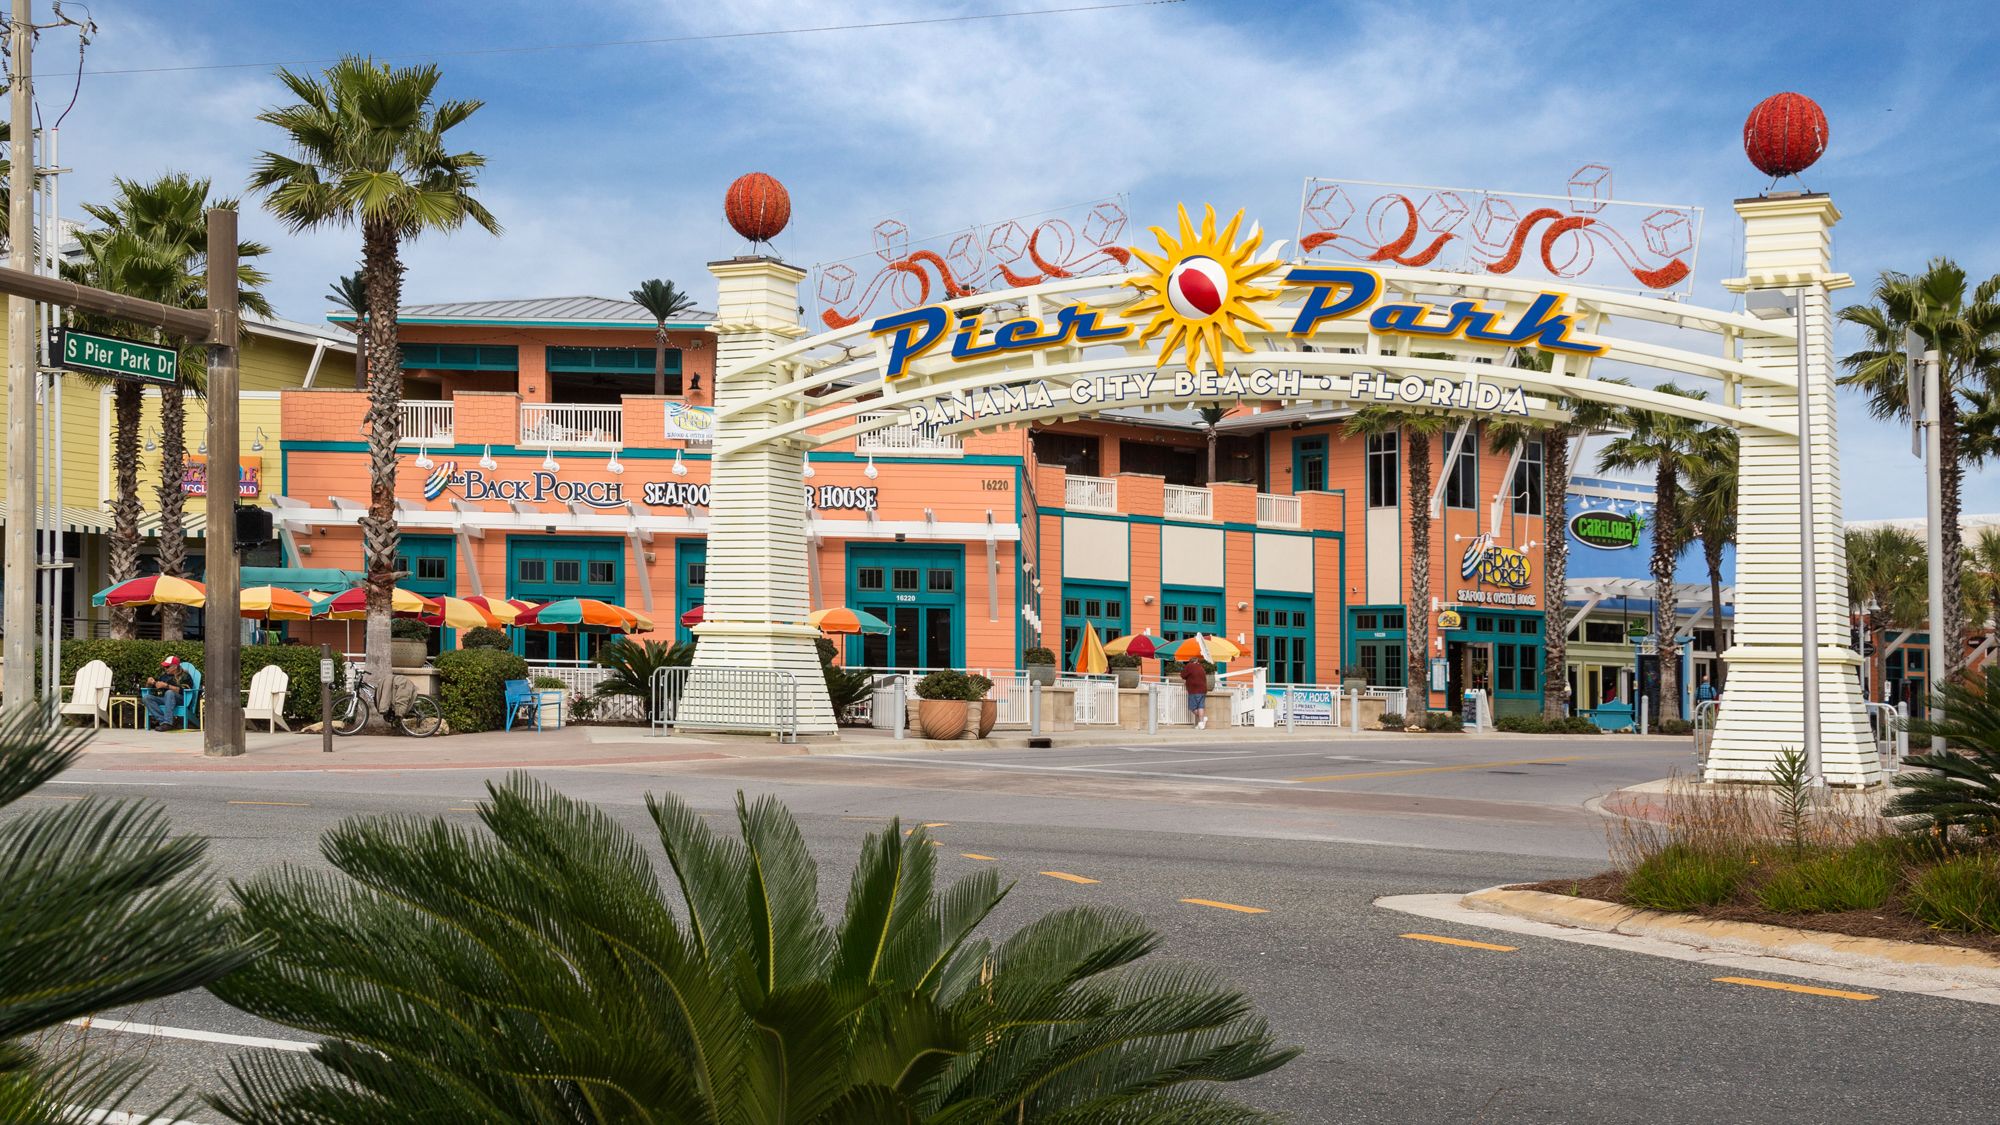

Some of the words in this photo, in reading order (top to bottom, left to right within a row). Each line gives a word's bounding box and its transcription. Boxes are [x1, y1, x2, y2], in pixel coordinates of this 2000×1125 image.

[868, 302, 1135, 383] Pier
[1279, 266, 1612, 357] Park
[67, 338, 77, 358] S
[85, 341, 114, 364] Pier
[120, 347, 151, 371] Park
[158, 355, 173, 375] Dr
[909, 381, 1055, 430] PANAMA
[1070, 372, 1157, 404] CITY
[1174, 367, 1302, 397] BEACH
[1350, 372, 1530, 417] FLORIDA
[446, 470, 465, 485] the
[981, 479, 1009, 491] 16220
[643, 482, 711, 506] SEAFOO
[818, 485, 879, 510] HOUSE
[1457, 590, 1486, 602] SEAFOOD
[1493, 592, 1517, 605] OYSTER
[1517, 594, 1537, 606] HOUSE
[1282, 691, 1308, 702] HPPY
[1309, 692, 1330, 703] HOUR
